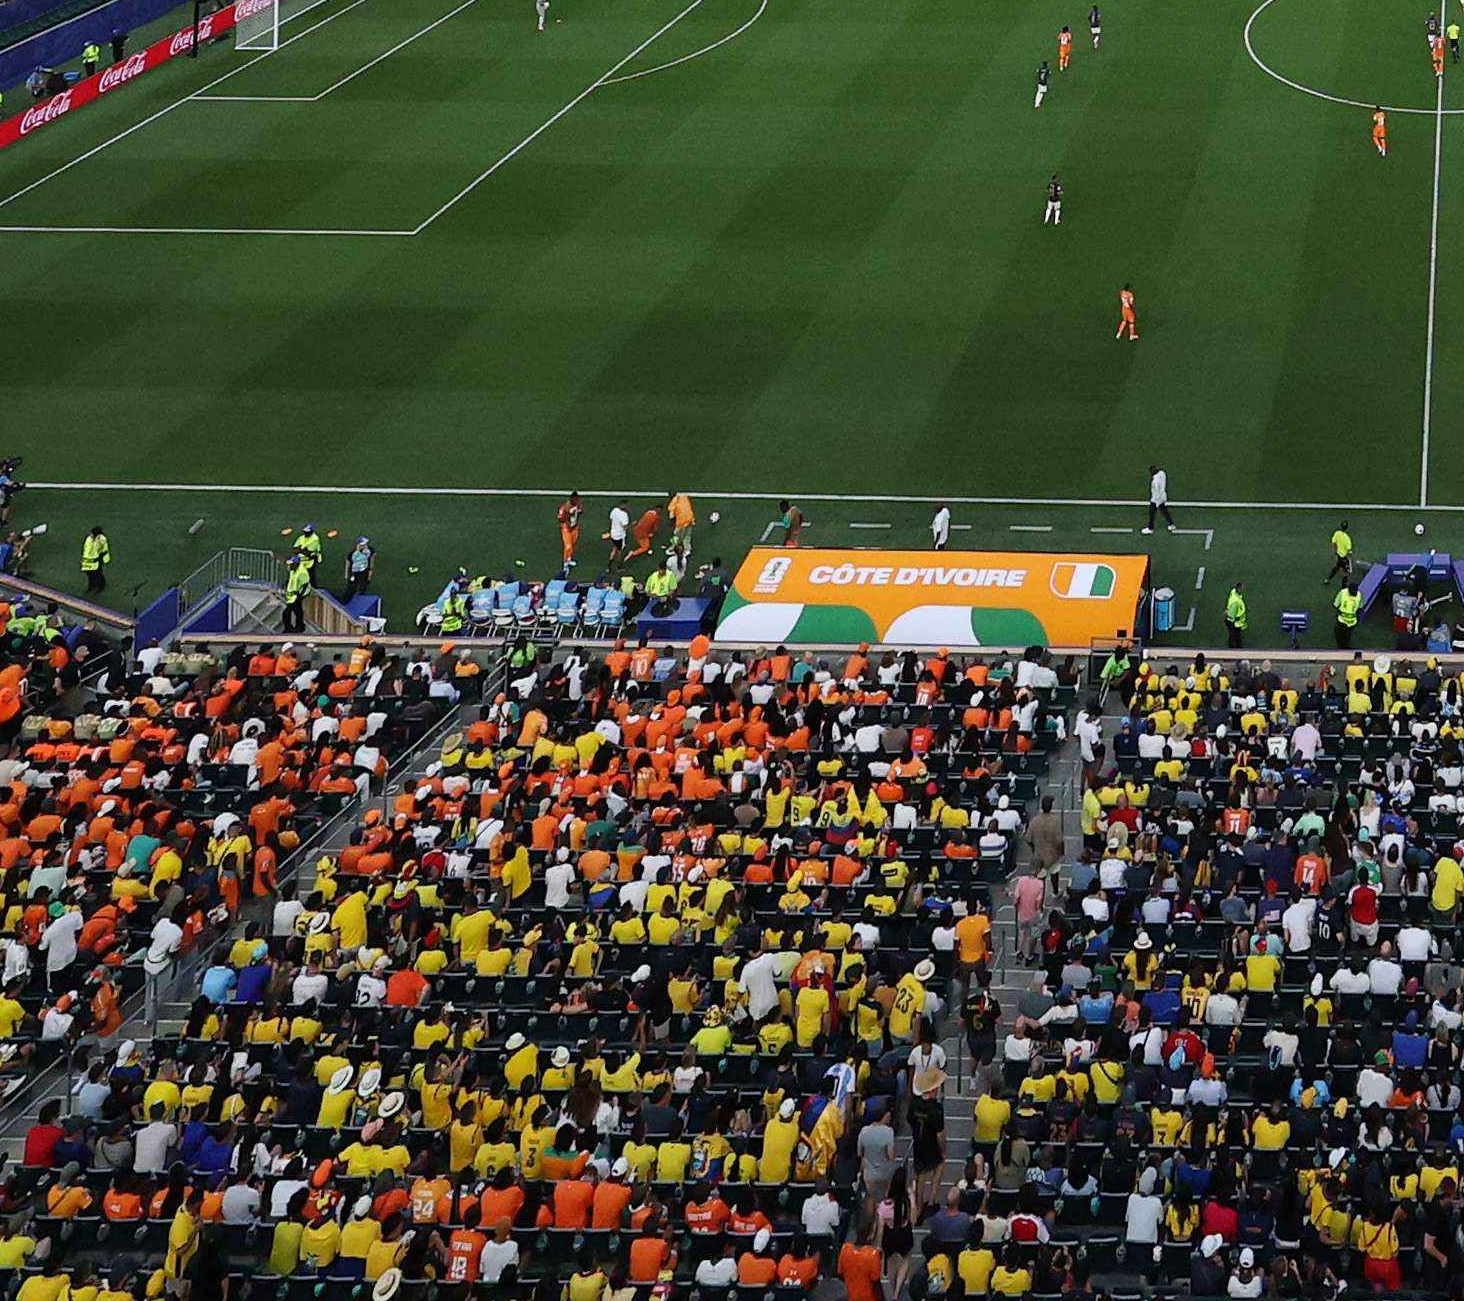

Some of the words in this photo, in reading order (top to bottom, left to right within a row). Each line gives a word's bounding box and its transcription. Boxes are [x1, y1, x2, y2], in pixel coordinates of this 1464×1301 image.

[809, 562, 891, 585] CÔTE
[894, 566, 1028, 587] D'IVOIRE
[1319, 921, 1331, 940] 10
